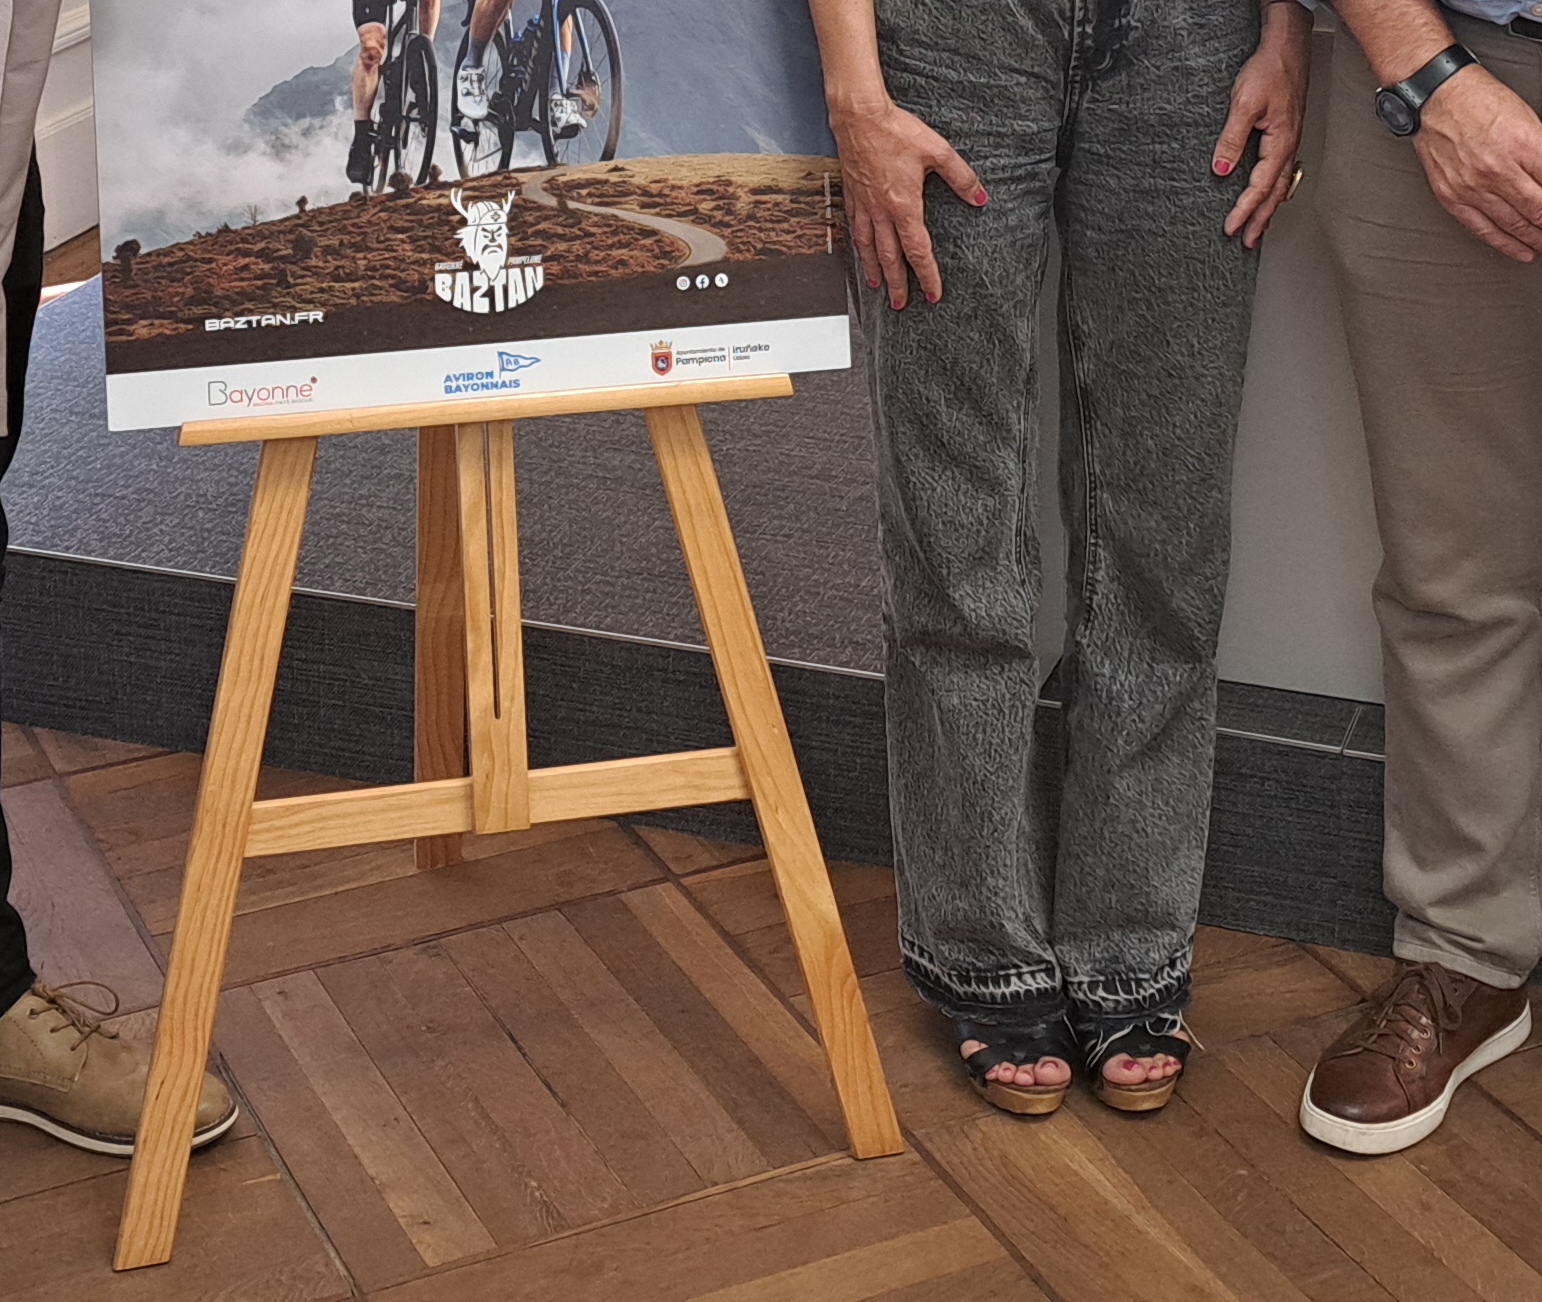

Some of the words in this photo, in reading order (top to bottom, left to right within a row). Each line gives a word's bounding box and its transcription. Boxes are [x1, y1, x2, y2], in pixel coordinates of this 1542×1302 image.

[435, 266, 544, 314] BAZTAN
[205, 310, 324, 332] BAZTAN.FR
[443, 370, 494, 384] AVIRON
[444, 379, 521, 395] BAYONNAIS
[207, 380, 313, 408] Bayonne
